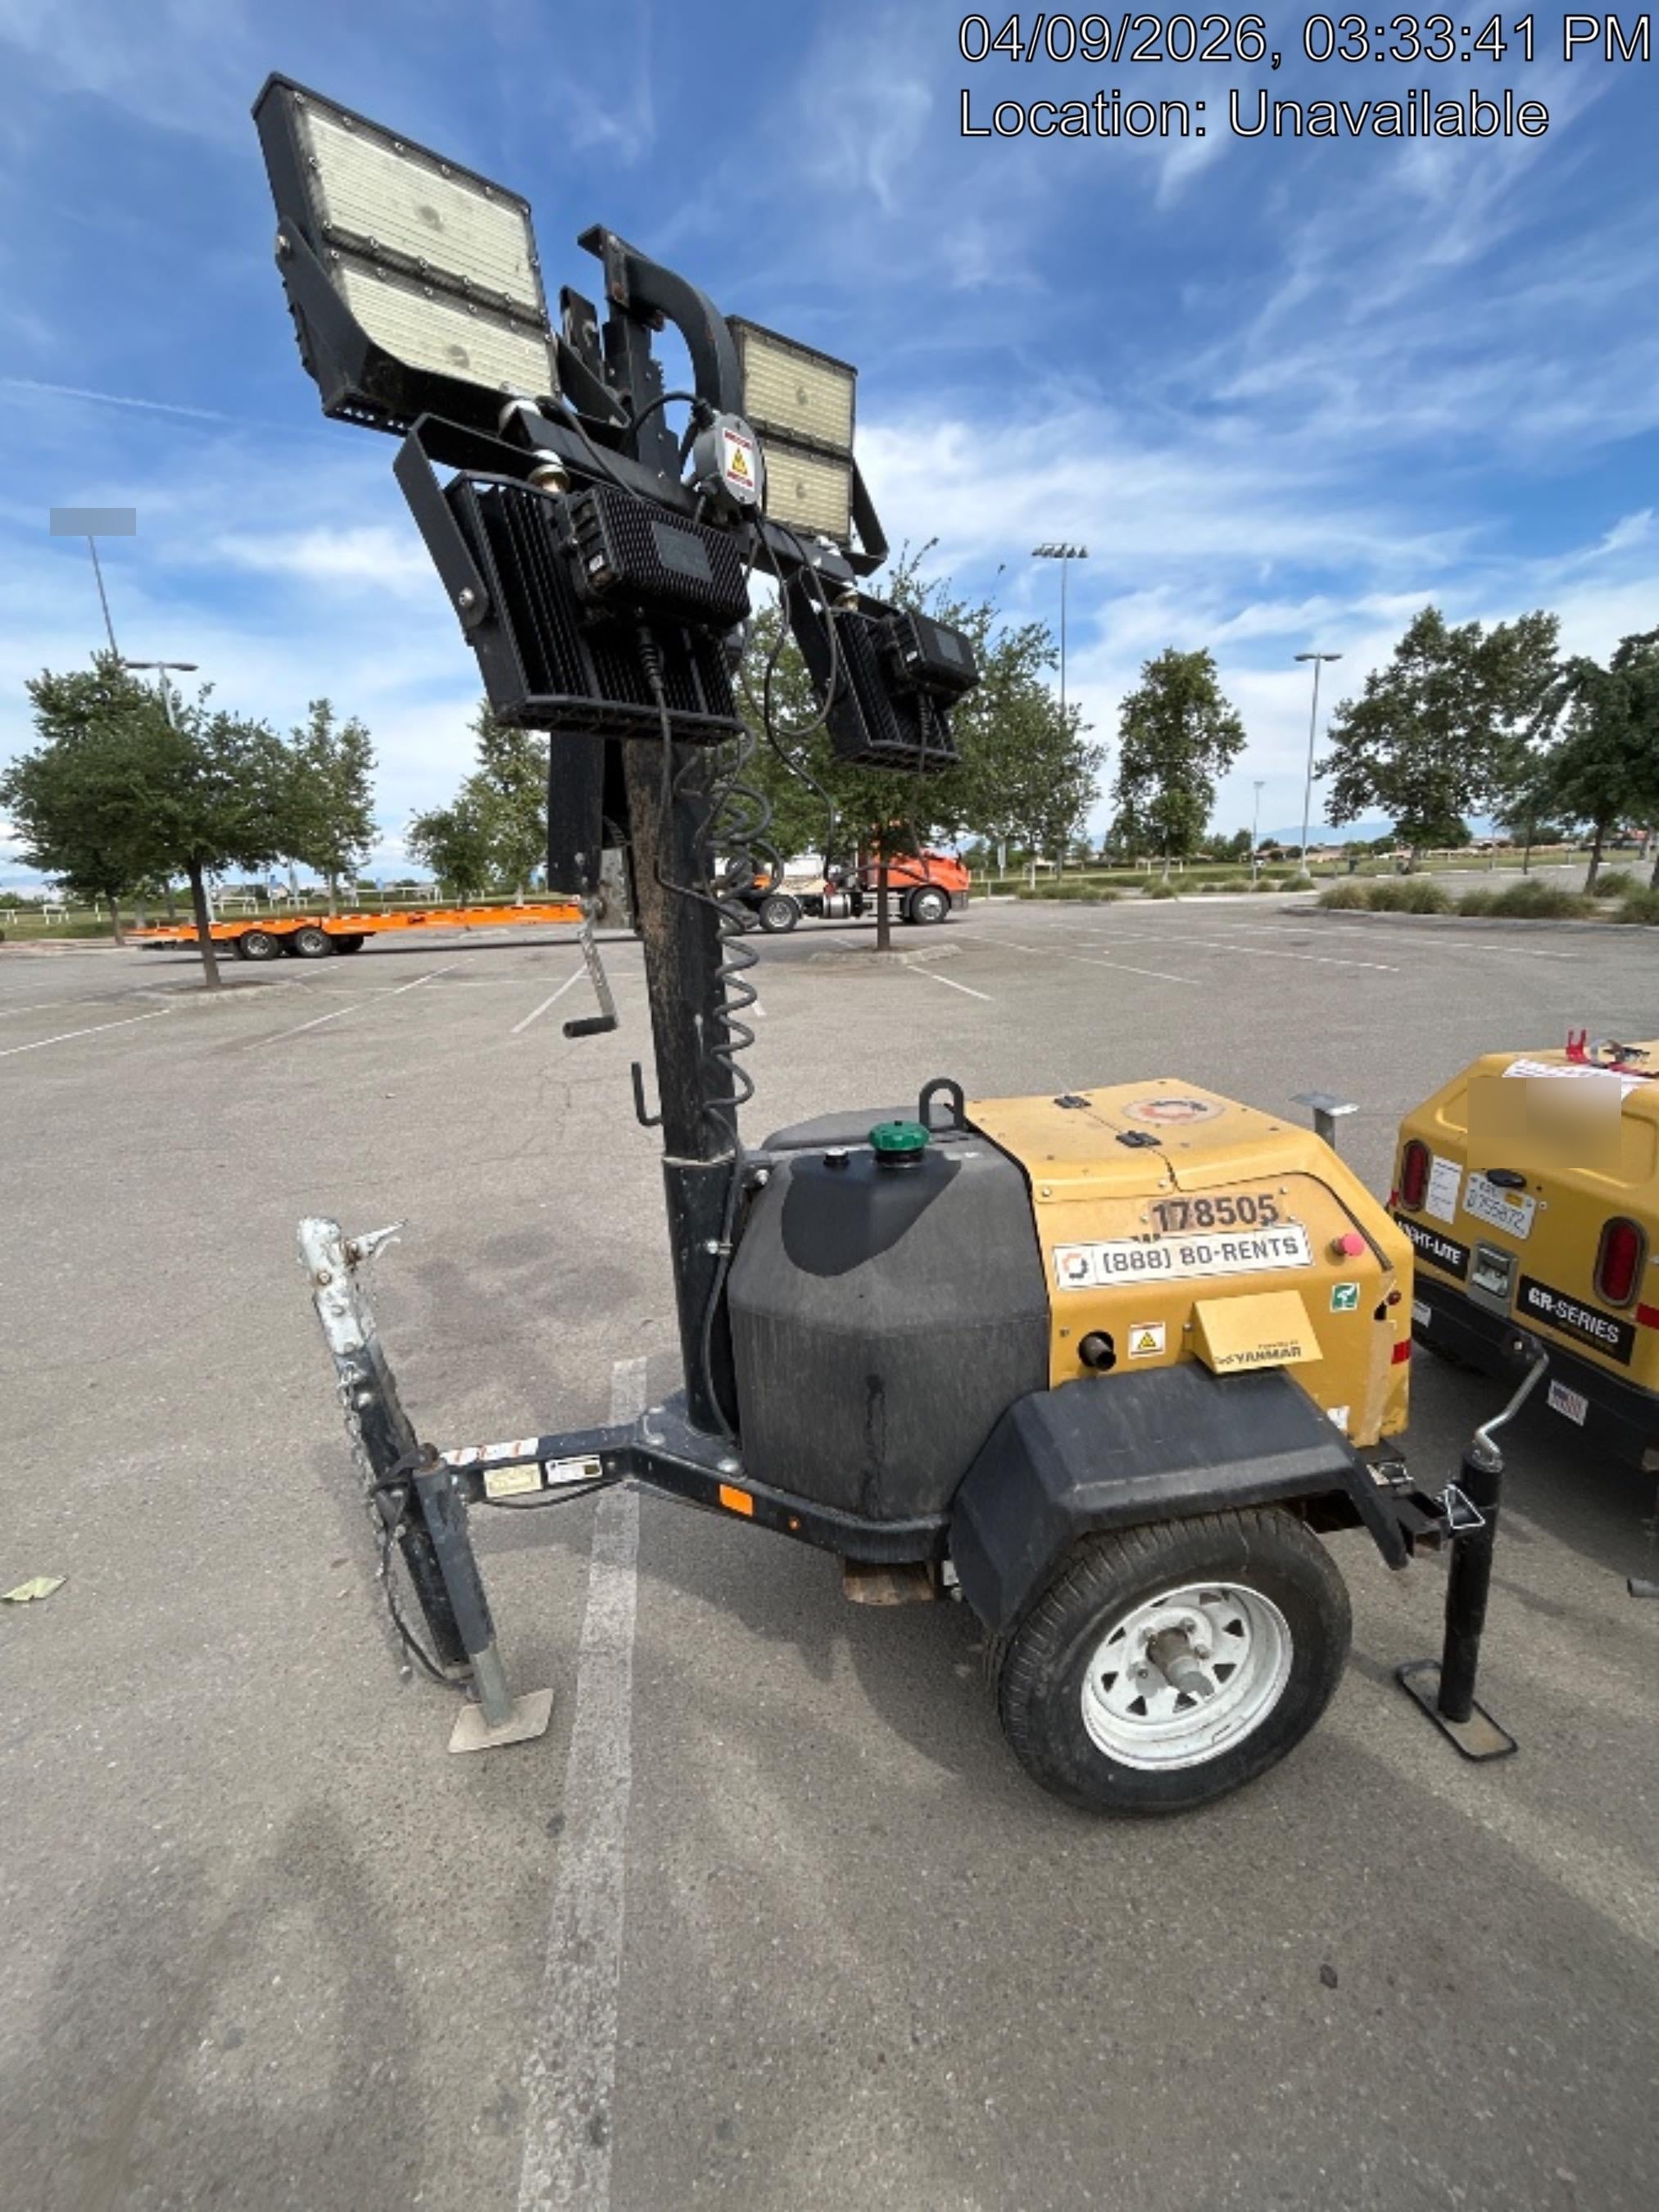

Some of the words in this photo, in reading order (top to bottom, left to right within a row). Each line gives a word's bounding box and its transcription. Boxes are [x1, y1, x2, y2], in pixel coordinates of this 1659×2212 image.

[1152, 1194, 1279, 1231] 178505
[1528, 1287, 1620, 1344] GR-SERIES
[1235, 1345, 1301, 1364] YANMAR
